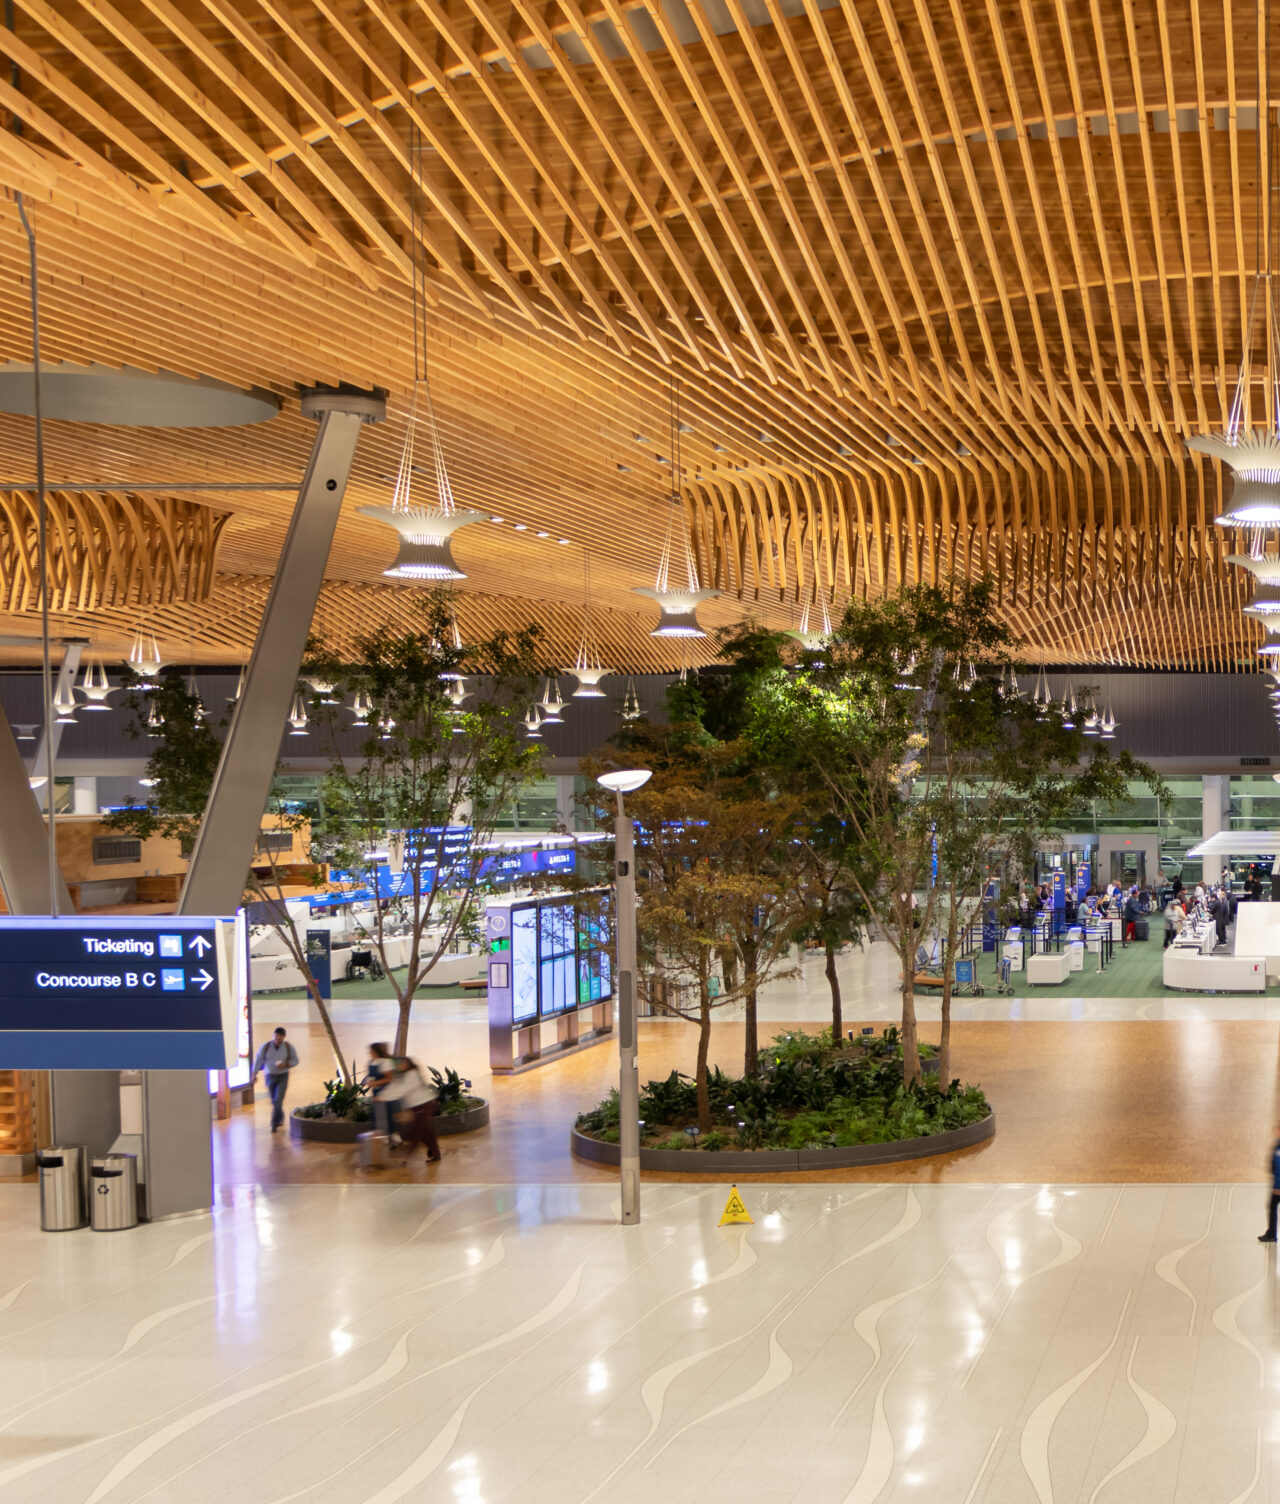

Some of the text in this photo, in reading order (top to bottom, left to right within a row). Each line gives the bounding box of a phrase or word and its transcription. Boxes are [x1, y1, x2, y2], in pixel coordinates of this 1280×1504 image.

[83, 938, 154, 956] Ticketing
[37, 972, 156, 988] Concourse B C
